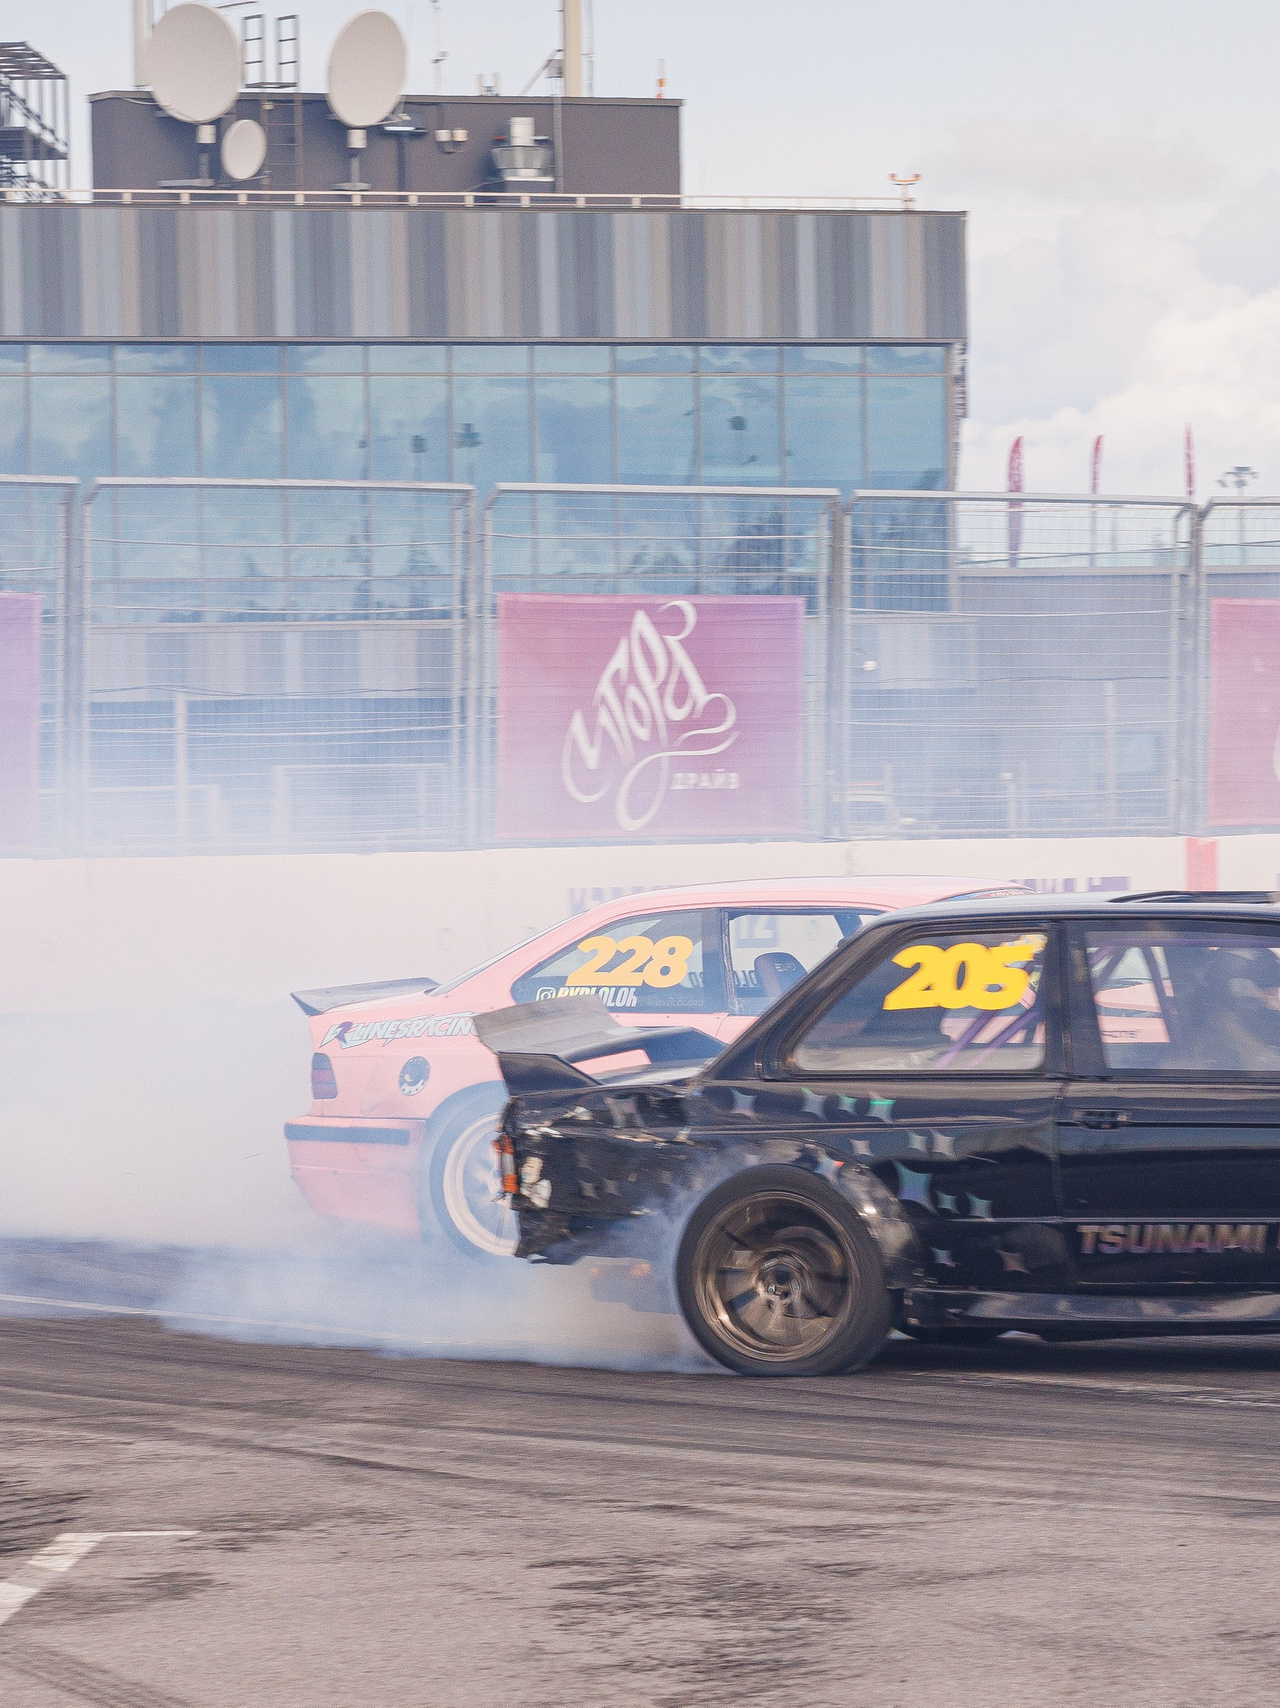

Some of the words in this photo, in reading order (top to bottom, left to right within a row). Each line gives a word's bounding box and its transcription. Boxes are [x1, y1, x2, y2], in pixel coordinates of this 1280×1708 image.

[565, 935, 694, 988] 228
[882, 942, 1035, 1010] 205
[1077, 1224, 1268, 1254] TSUNAMI
